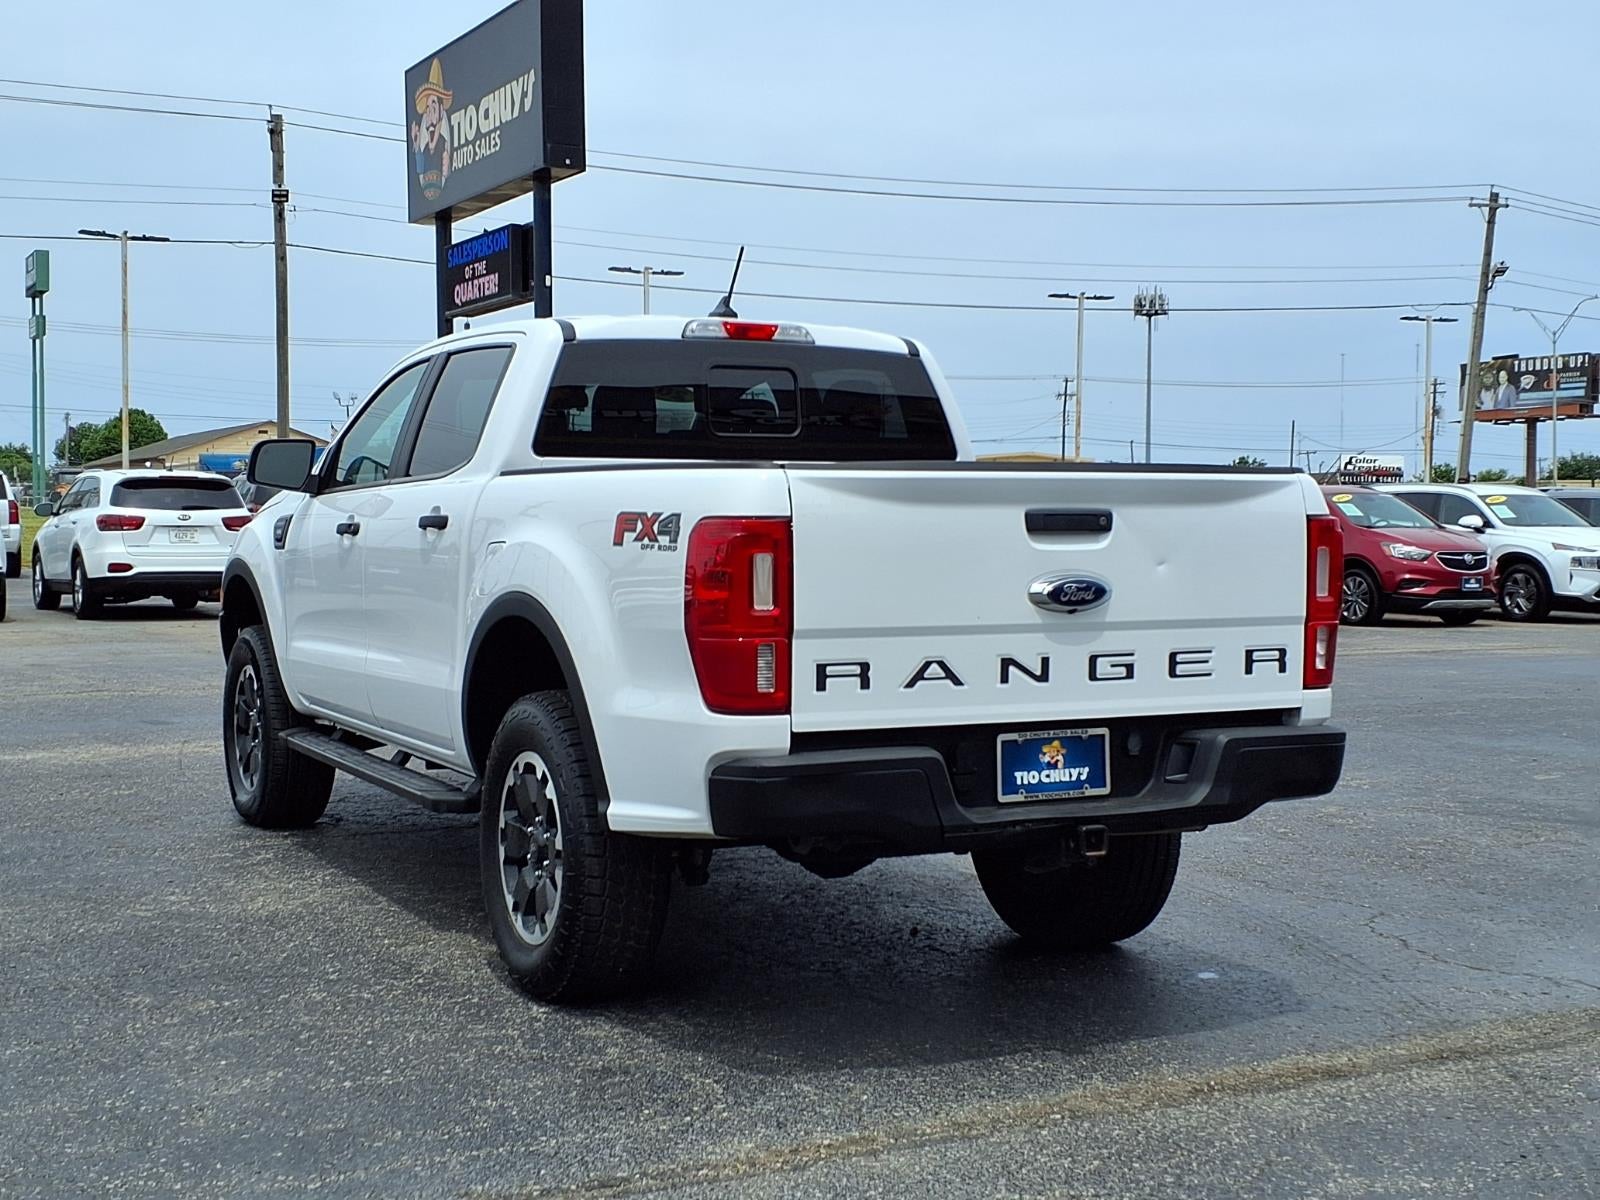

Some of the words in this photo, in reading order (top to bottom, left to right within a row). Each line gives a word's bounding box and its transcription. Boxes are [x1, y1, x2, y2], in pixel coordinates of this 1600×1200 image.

[451, 104, 477, 147] TIO
[479, 68, 536, 133] CHUY'S
[451, 144, 474, 172] AUTO
[475, 130, 501, 161] SALES
[447, 229, 508, 268] SALESPERSON
[464, 264, 473, 279] OF
[474, 260, 487, 277] THE
[454, 272, 499, 306] QUARTER!
[1513, 356, 1563, 373] THUNDER
[1569, 354, 1589, 368] UP!
[1344, 461, 1402, 472] Creations
[1348, 456, 1379, 465] Color
[612, 511, 682, 547] FX4
[640, 543, 656, 551] OFF
[657, 544, 678, 552] ROAD
[1060, 583, 1097, 602] Ford
[815, 646, 1287, 692] RANGER
[1014, 770, 1040, 785] TIO
[1040, 766, 1090, 783] CHUY'S
